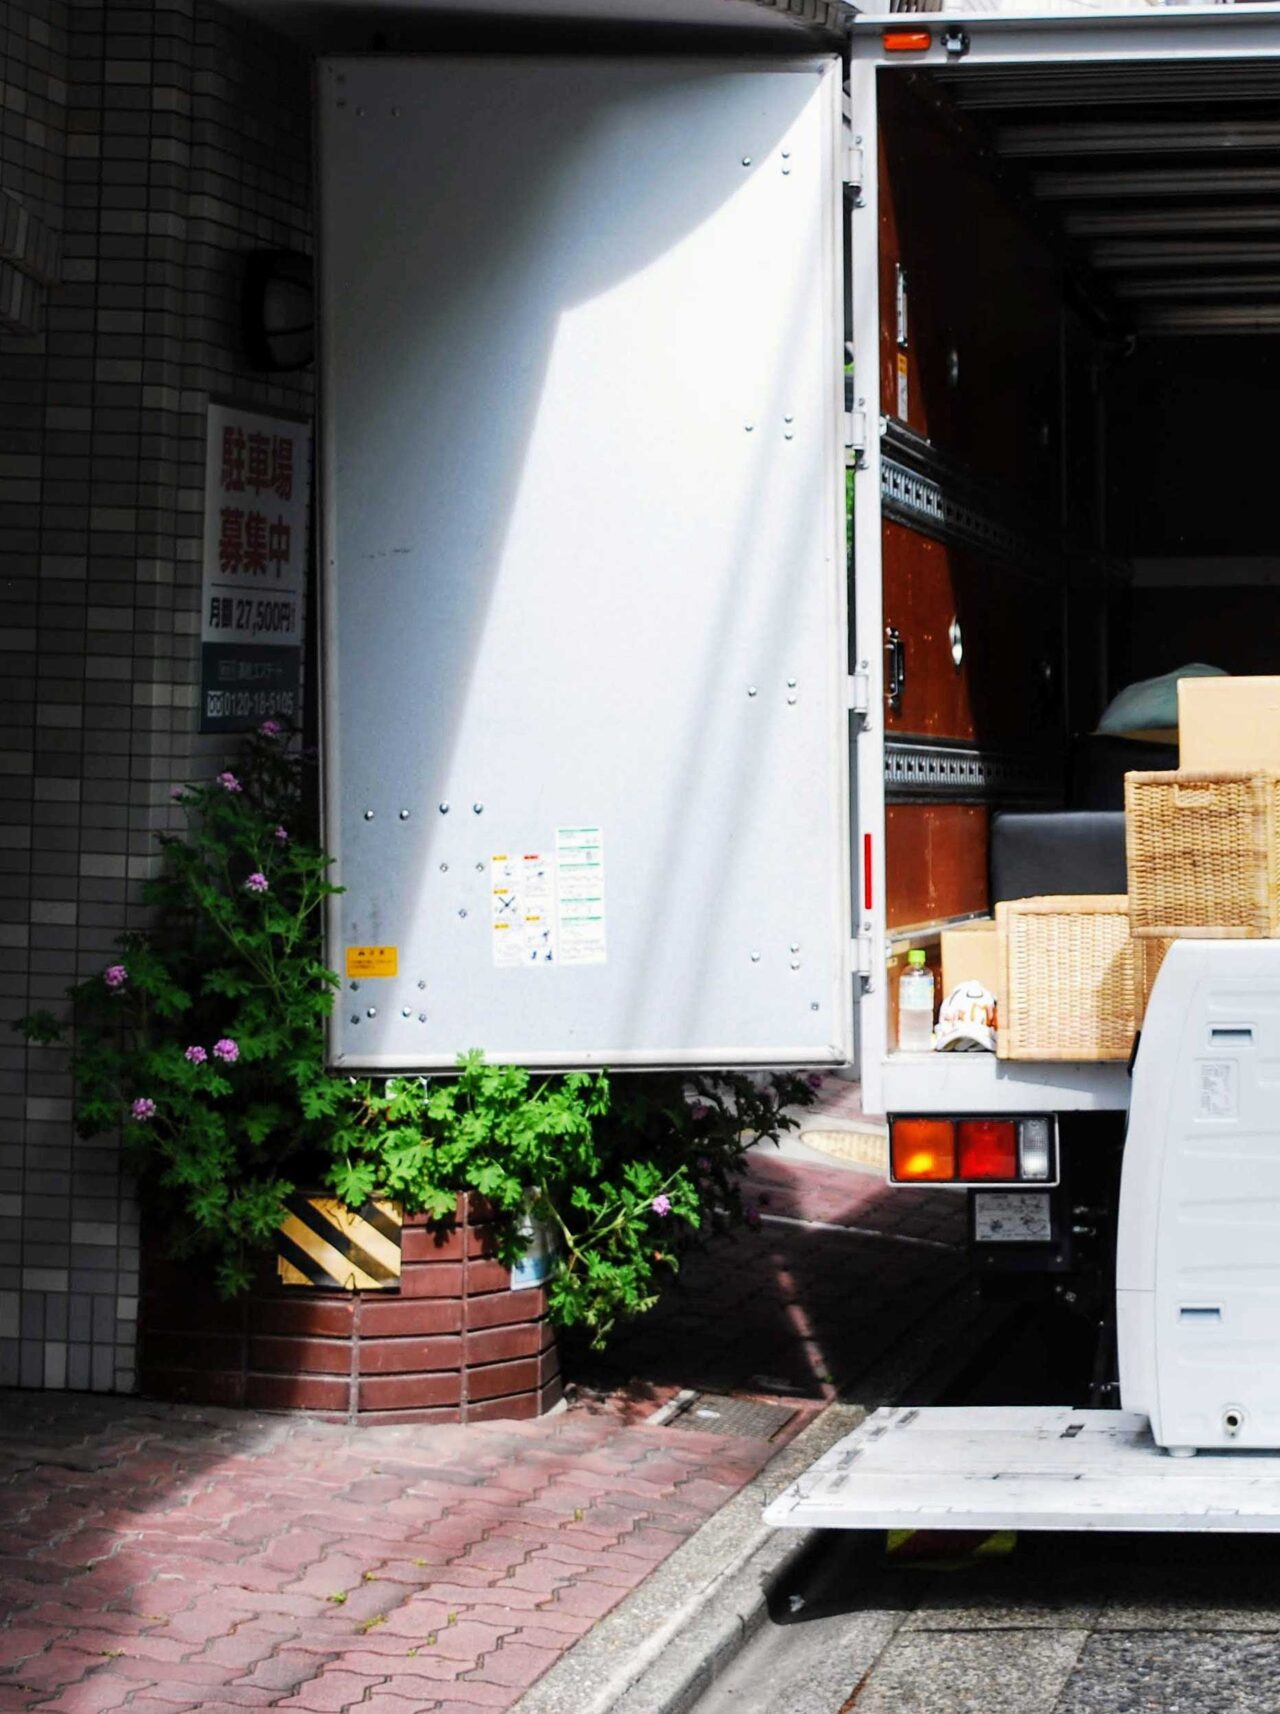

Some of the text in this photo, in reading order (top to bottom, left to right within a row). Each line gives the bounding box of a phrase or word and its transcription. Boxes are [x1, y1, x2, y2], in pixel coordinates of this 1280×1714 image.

[222, 426, 294, 501] 駐車場
[219, 506, 291, 578] 募集中
